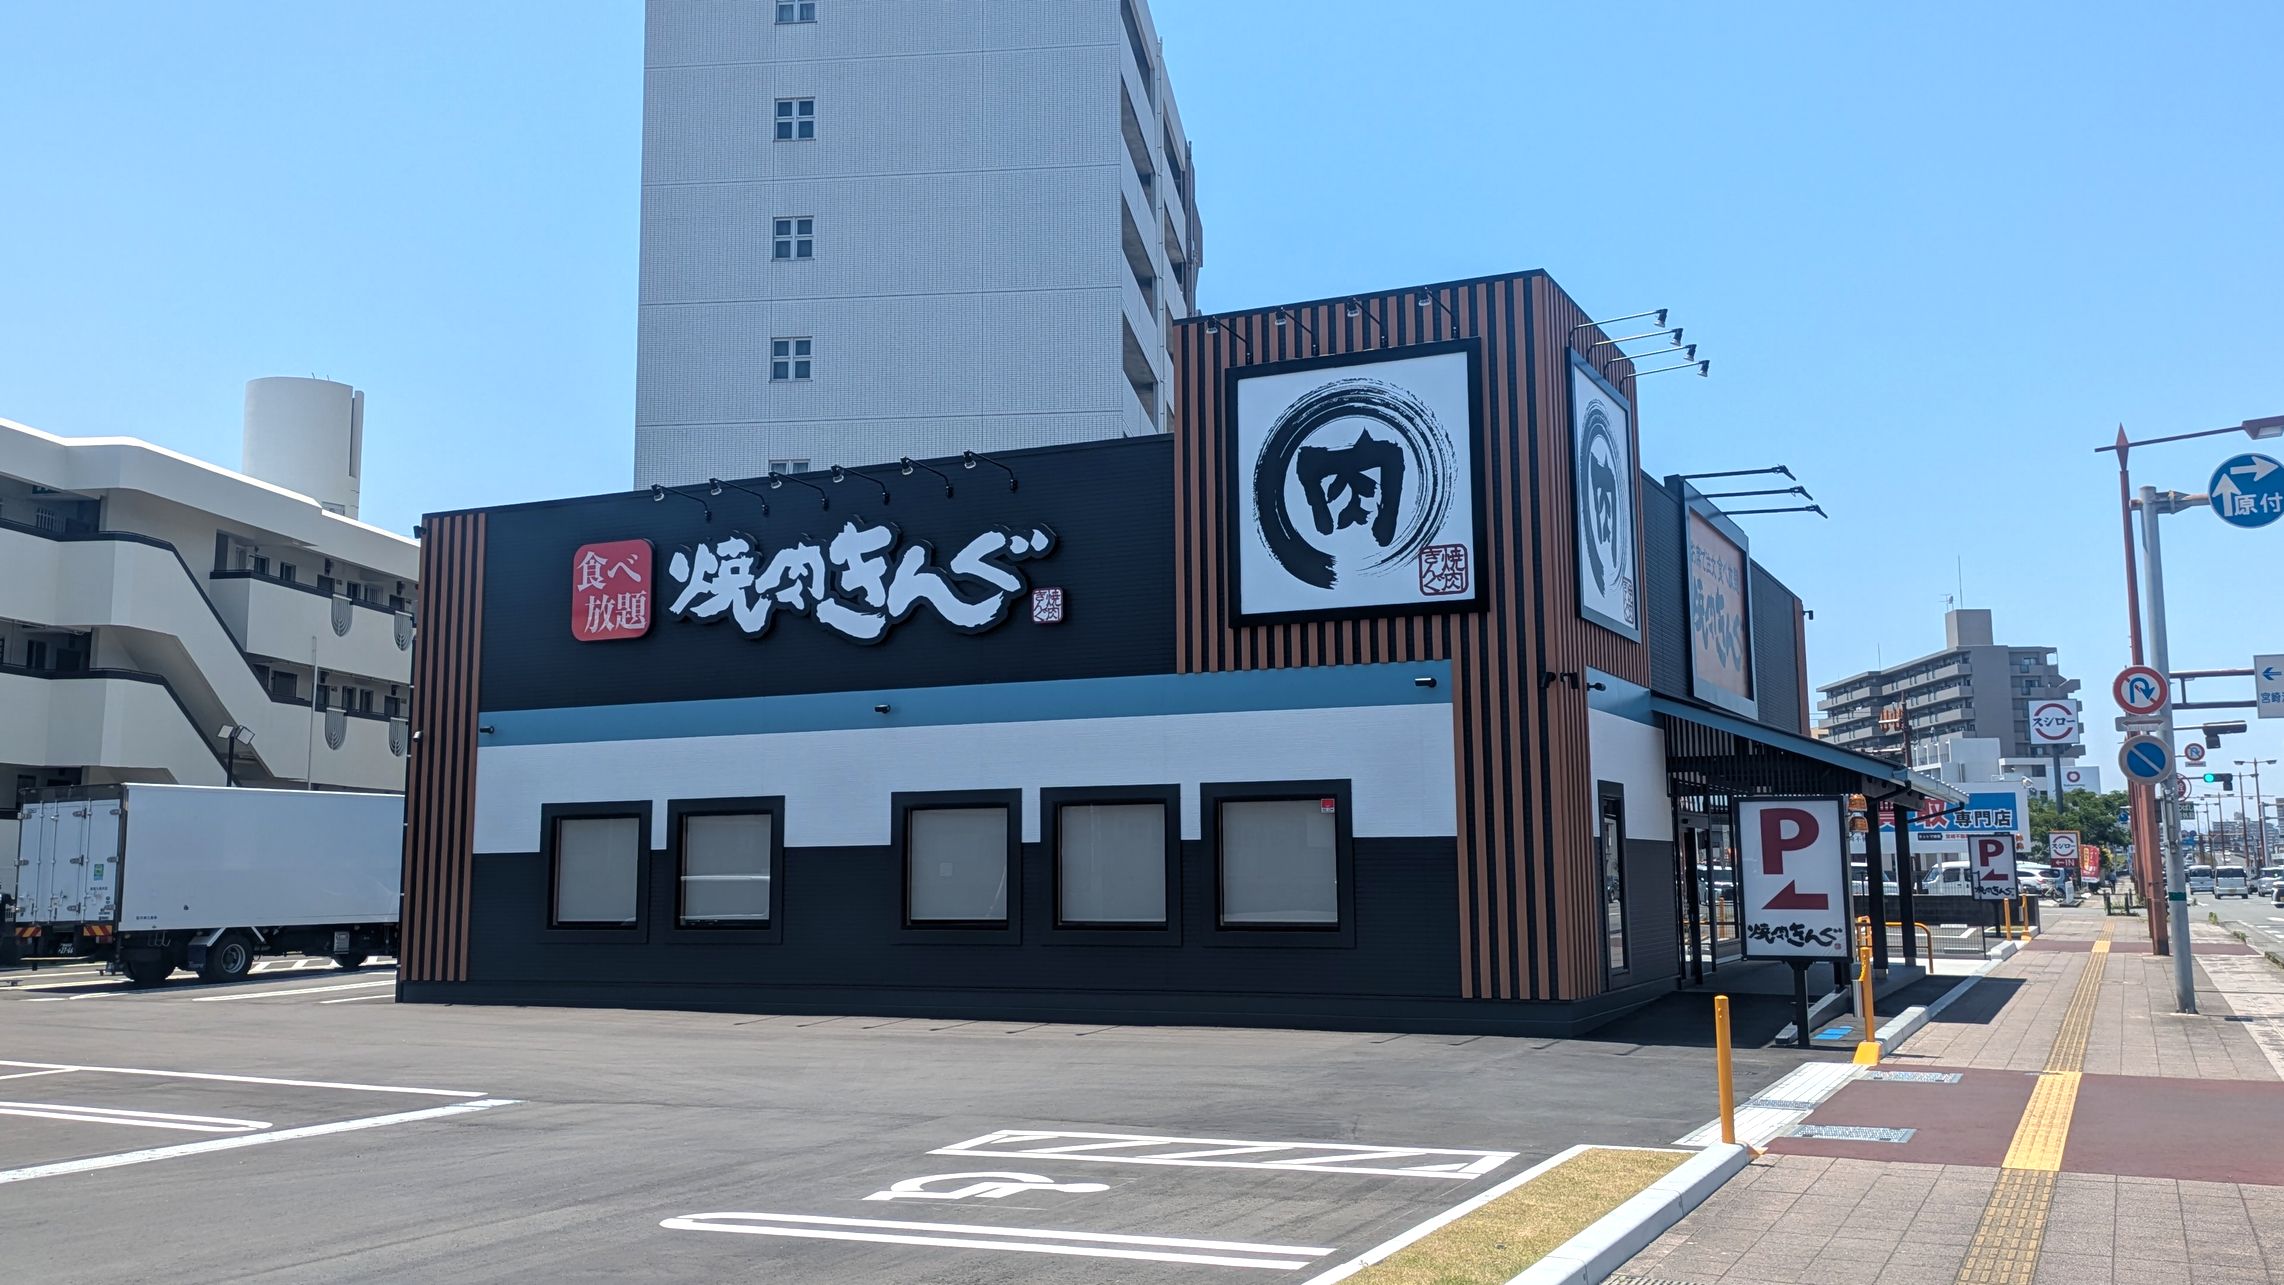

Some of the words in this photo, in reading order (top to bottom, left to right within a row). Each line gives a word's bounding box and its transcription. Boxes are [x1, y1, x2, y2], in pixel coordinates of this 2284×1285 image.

[1296, 427, 1405, 548] 肉
[2235, 493, 2283, 515] 原付
[1590, 451, 1618, 569] 肉
[576, 551, 641, 591] 食べ
[668, 521, 1050, 640] 焼肉きんぐ
[584, 589, 647, 635] 放題
[2261, 692, 2284, 704] 宮崎
[2033, 717, 2076, 727] スシロー
[1760, 808, 1820, 875] P
[1979, 839, 2005, 867] P
[2065, 859, 2075, 867] IN
[1748, 922, 1843, 948] 焼肉きんぐ
